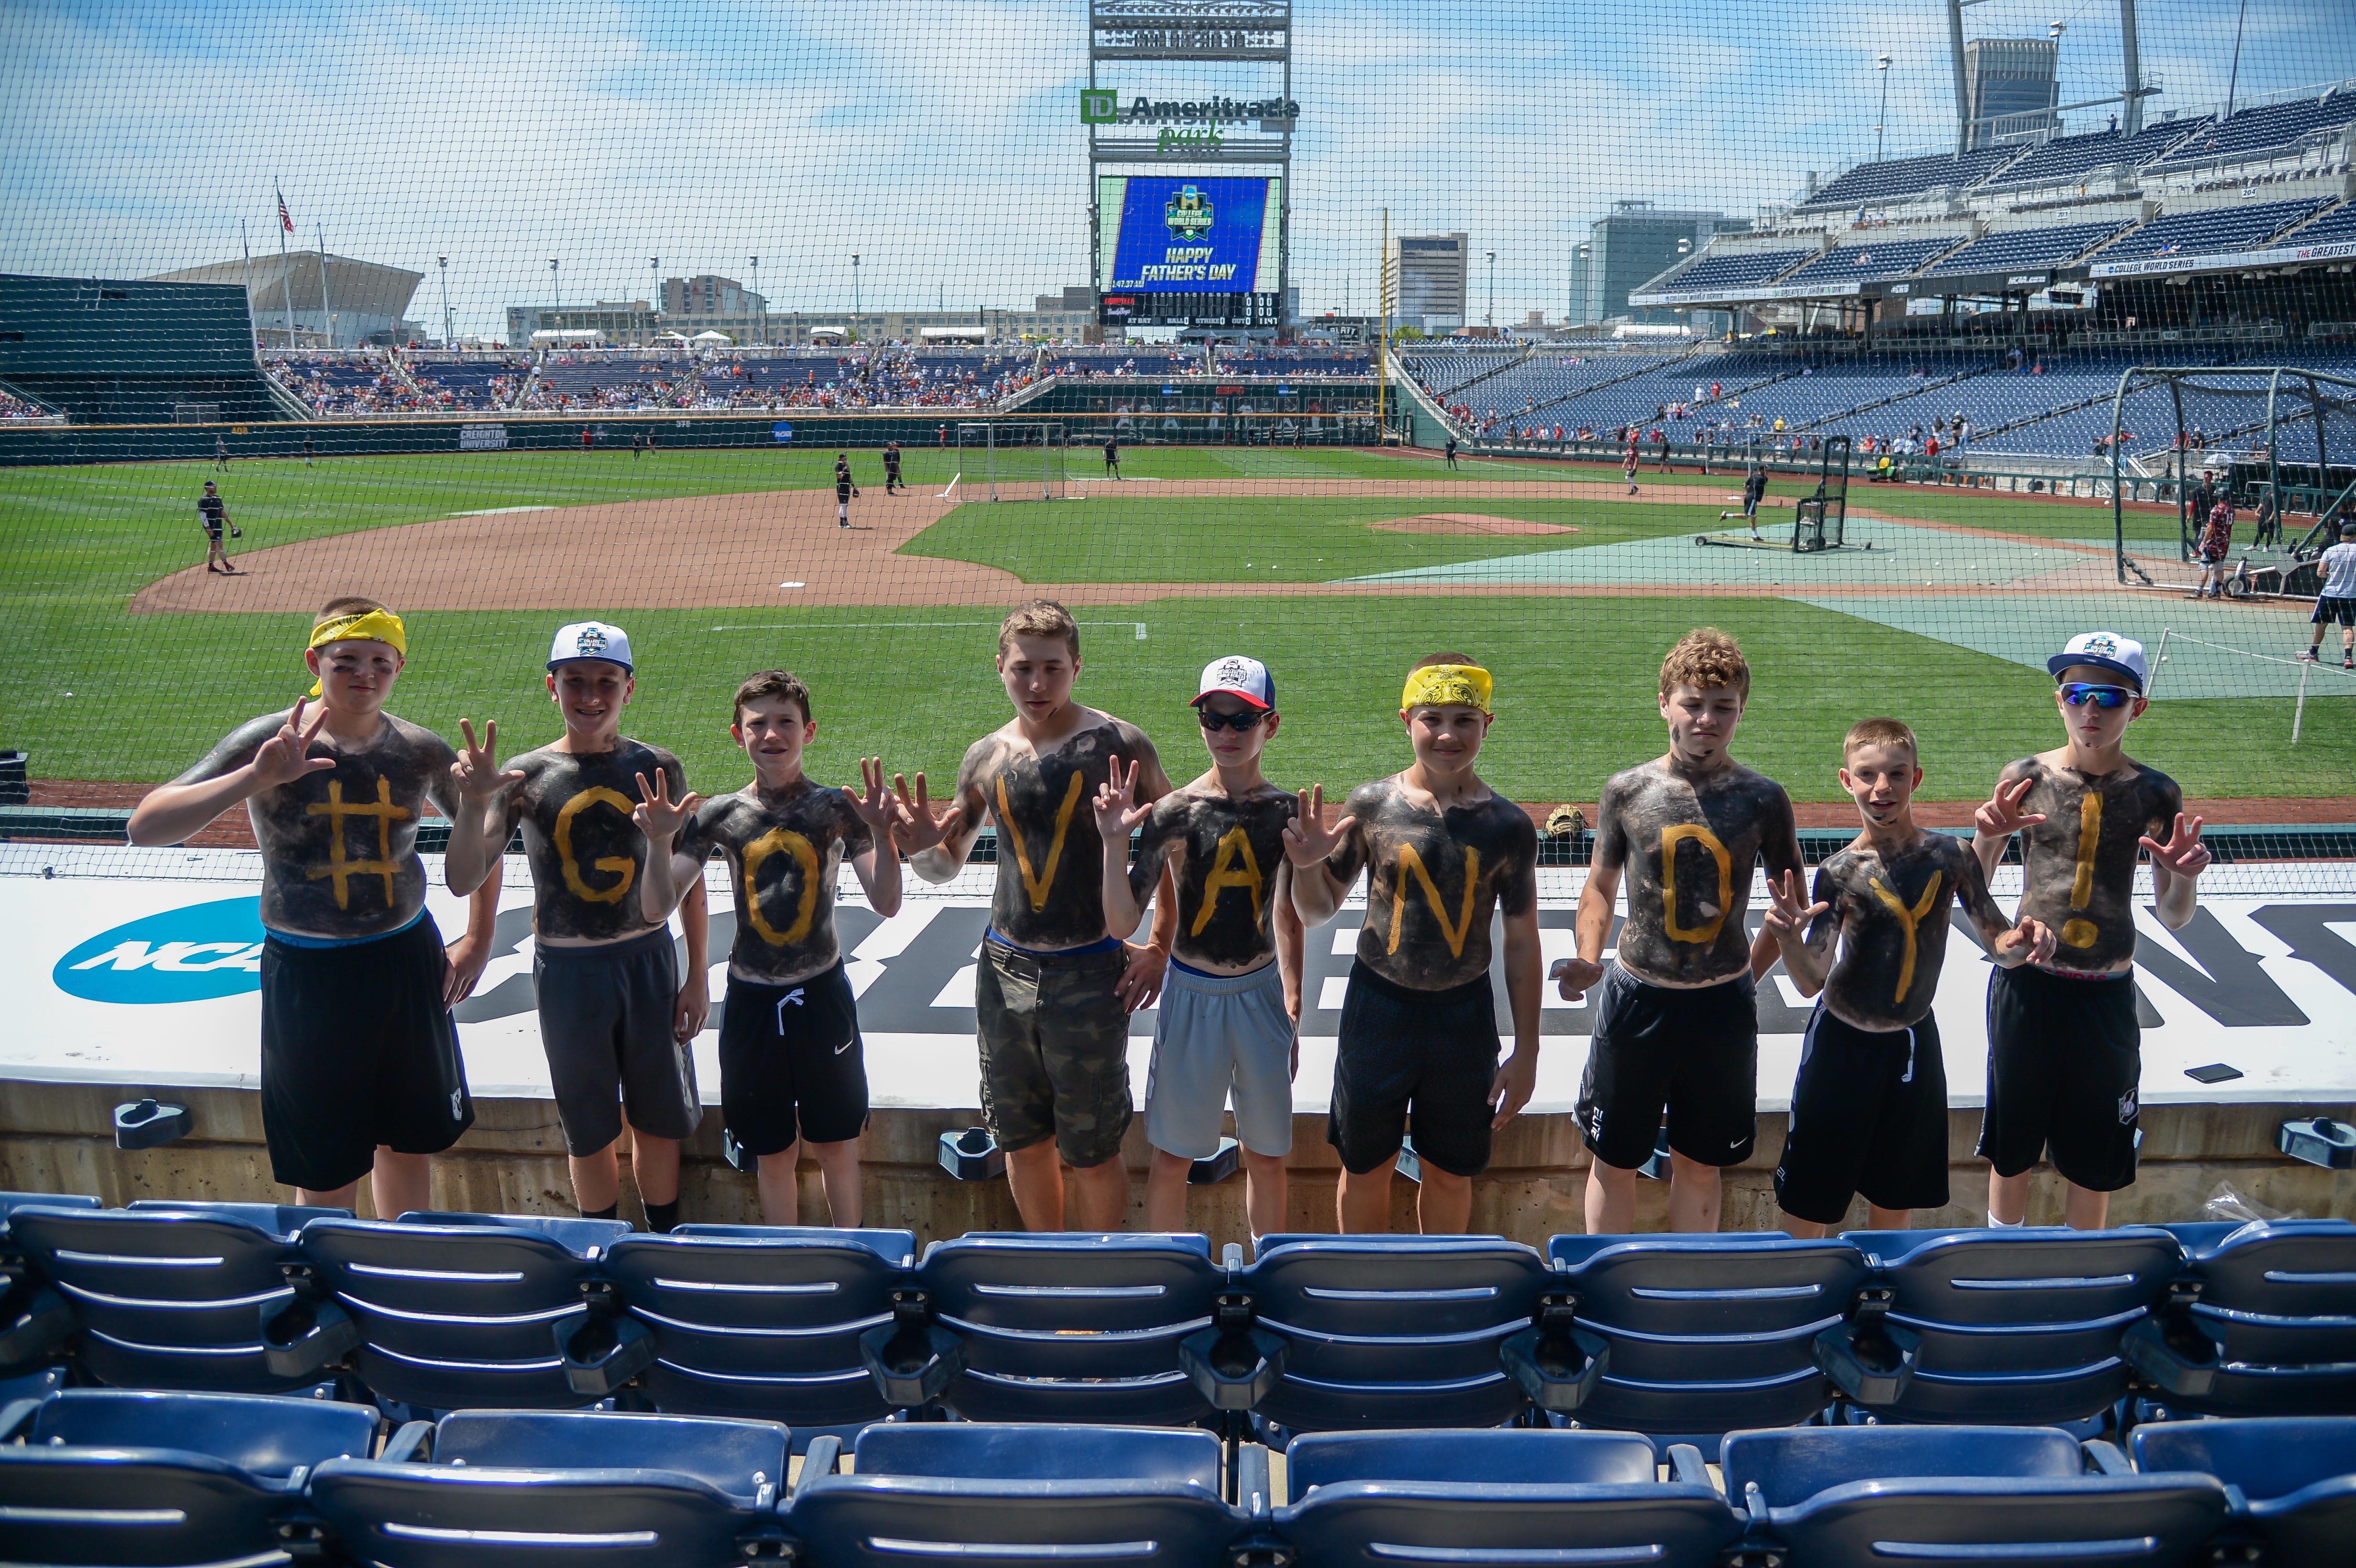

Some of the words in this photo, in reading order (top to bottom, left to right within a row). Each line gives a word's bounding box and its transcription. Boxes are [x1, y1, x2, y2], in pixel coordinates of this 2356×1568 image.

[1085, 96, 1113, 116] TD
[1130, 96, 1299, 118] Ameritrade
[1157, 119, 1223, 155] park
[1165, 248, 1213, 263] HAPPY
[2298, 250, 2311, 258] THE
[2311, 244, 2356, 257] GREATEST
[1141, 264, 1206, 281] FATHER'S
[1208, 264, 1236, 281] DAY
[2115, 263, 2142, 273] COLLEGE
[2144, 261, 2166, 271] WORLD
[2169, 260, 2194, 269] SERIES
[1246, 297, 1252, 306] 0
[1258, 297, 1264, 306] 0
[1267, 297, 1272, 306] 0
[1246, 307, 1252, 316] 0
[1258, 307, 1264, 316] 0
[1184, 317, 1189, 325] 0
[1220, 317, 1225, 325] 0
[1245, 317, 1251, 325] 0
[460, 430, 506, 439] CREIGHTON
[460, 439, 509, 448] UNIVERSITY
[306, 774, 410, 910] #
[554, 785, 635, 905] G
[742, 827, 819, 946] O
[996, 771, 1082, 913] V
[1191, 824, 1265, 937] A
[1386, 843, 1480, 958] N
[1661, 824, 1734, 944] D
[1868, 870, 1941, 1003] Y
[2062, 792, 2102, 948] !
[68, 941, 264, 972] NCA
